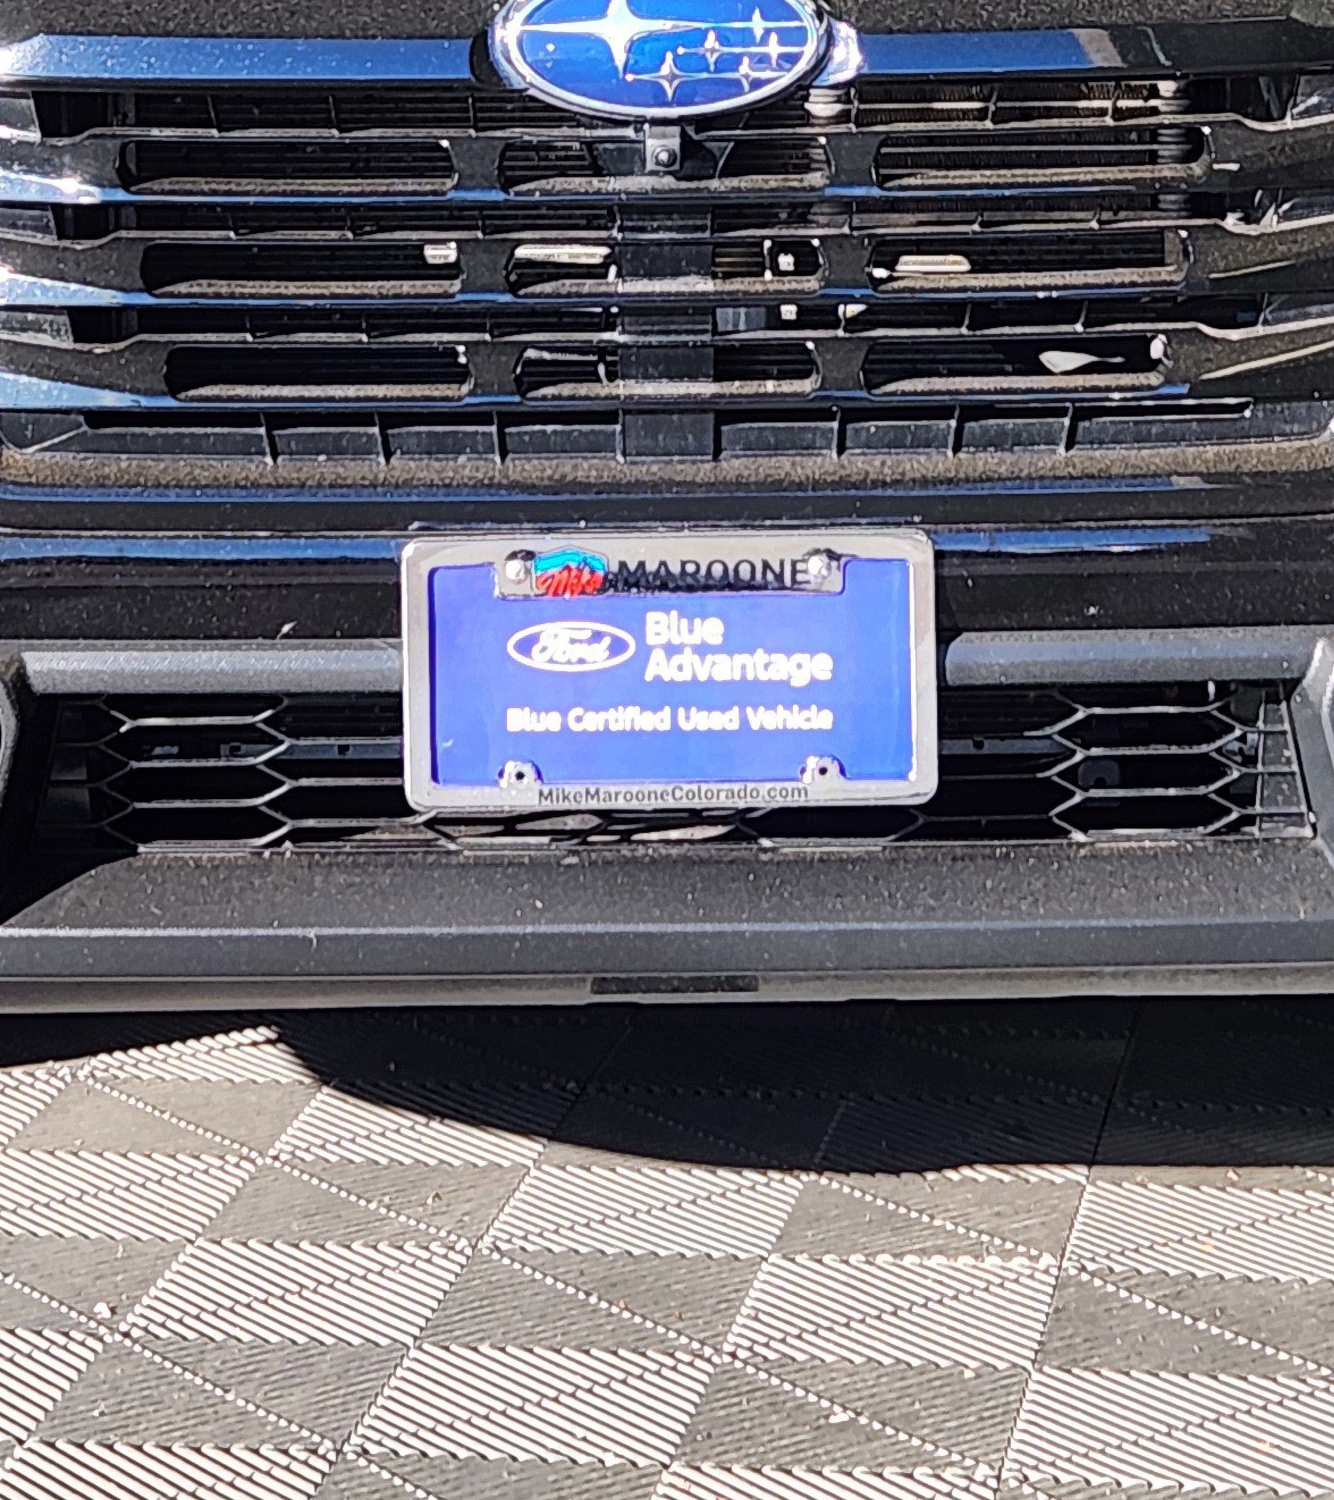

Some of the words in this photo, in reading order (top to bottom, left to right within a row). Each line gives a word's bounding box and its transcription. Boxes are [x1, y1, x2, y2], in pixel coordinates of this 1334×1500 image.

[618, 558, 811, 587] MAROONE
[645, 610, 724, 645] Blue
[531, 627, 610, 665] Ford
[644, 648, 833, 686] Advantage
[506, 707, 562, 732] Blue
[567, 706, 671, 731] Certified
[678, 706, 740, 731] Used
[746, 704, 834, 730] Vehicle
[538, 783, 809, 805] MikeMarooneColorado.com
